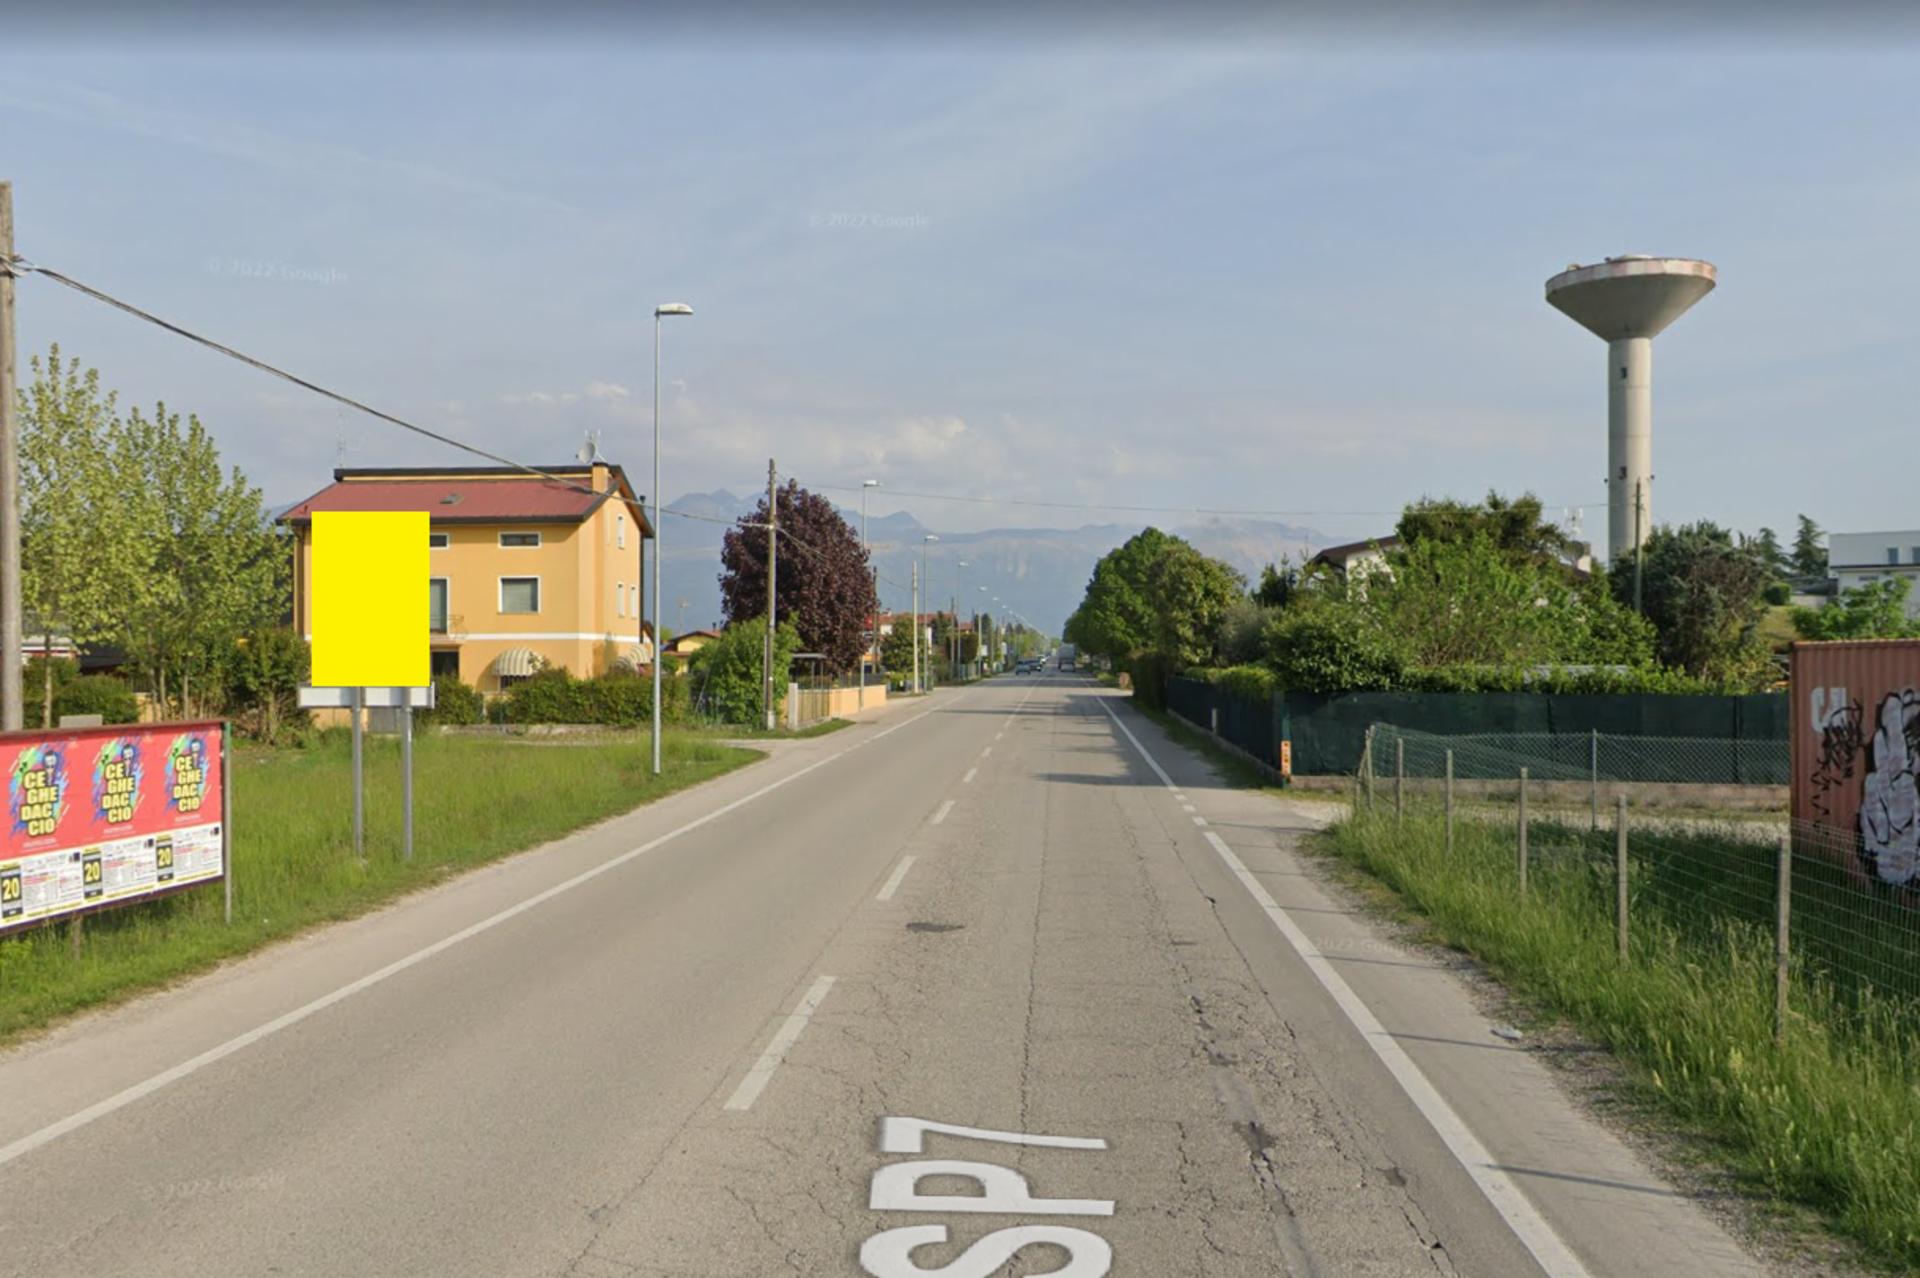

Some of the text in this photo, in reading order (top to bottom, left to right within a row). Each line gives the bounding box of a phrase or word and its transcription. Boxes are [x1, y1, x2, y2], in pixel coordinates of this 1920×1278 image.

[23, 771, 46, 789] CE
[105, 763, 124, 780] CE
[107, 777, 134, 794] GHE
[26, 786, 58, 805] GHE
[102, 792, 129, 809] DAC
[21, 803, 52, 821] DAC
[108, 805, 132, 822] CIO
[28, 818, 55, 836] CIO
[158, 847, 171, 867] 20
[84, 861, 100, 882] 20
[2, 877, 20, 900] 20
